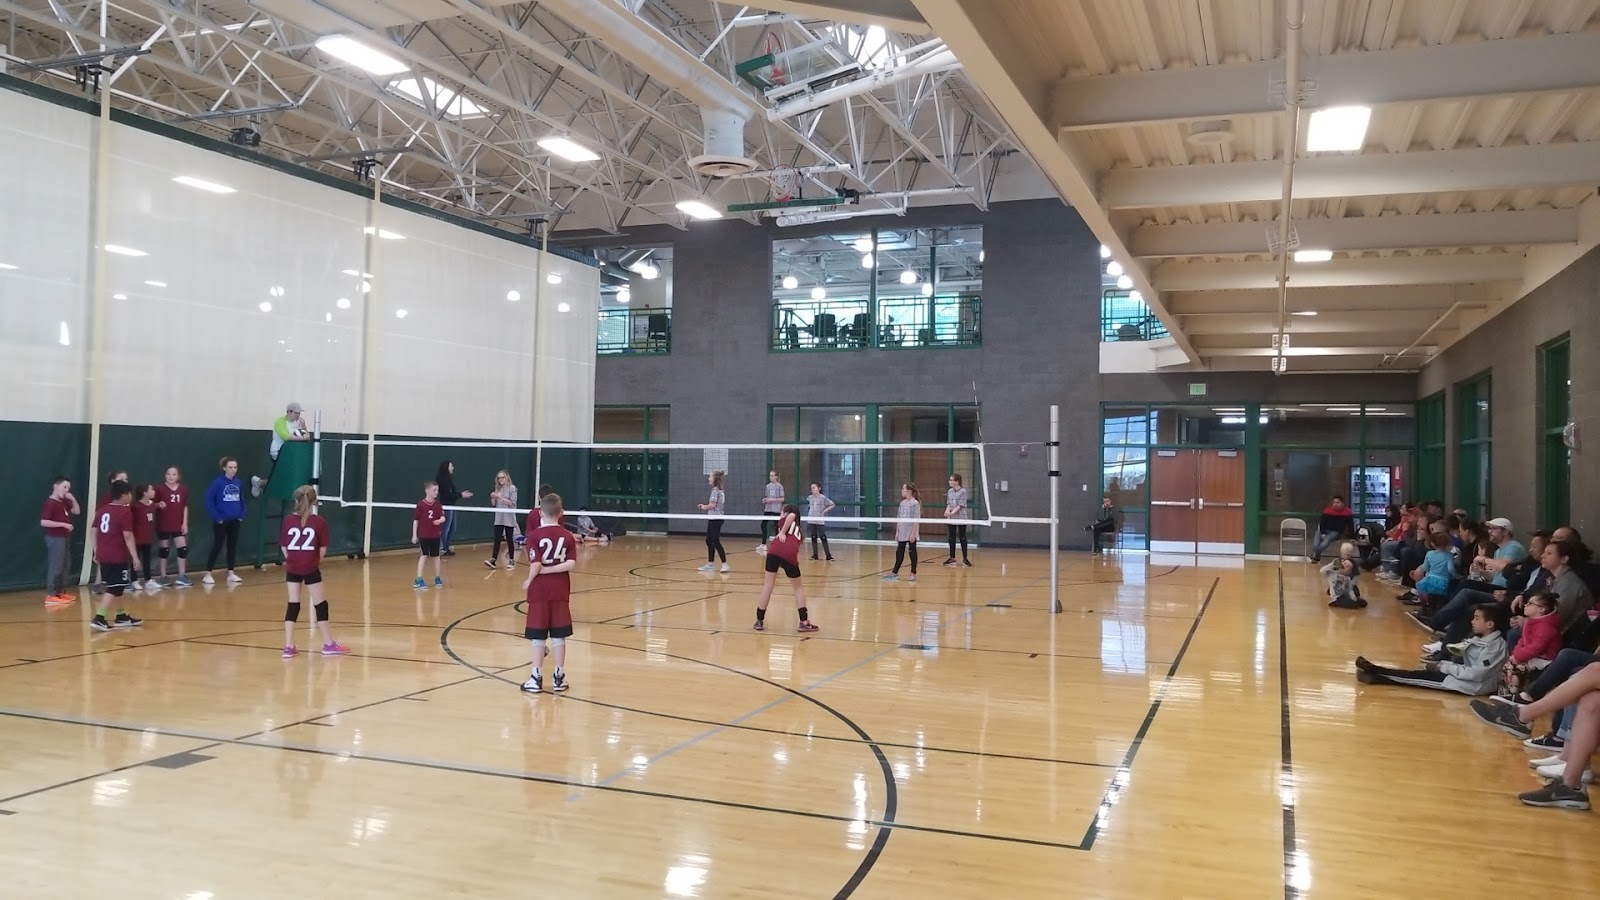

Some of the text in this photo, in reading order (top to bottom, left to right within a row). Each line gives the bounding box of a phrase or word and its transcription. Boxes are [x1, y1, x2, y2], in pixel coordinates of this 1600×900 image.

[170, 494, 181, 503] 21
[100, 512, 110, 534] 8
[428, 510, 434, 519] 2
[287, 527, 315, 551] 22
[539, 536, 567, 564] 24
